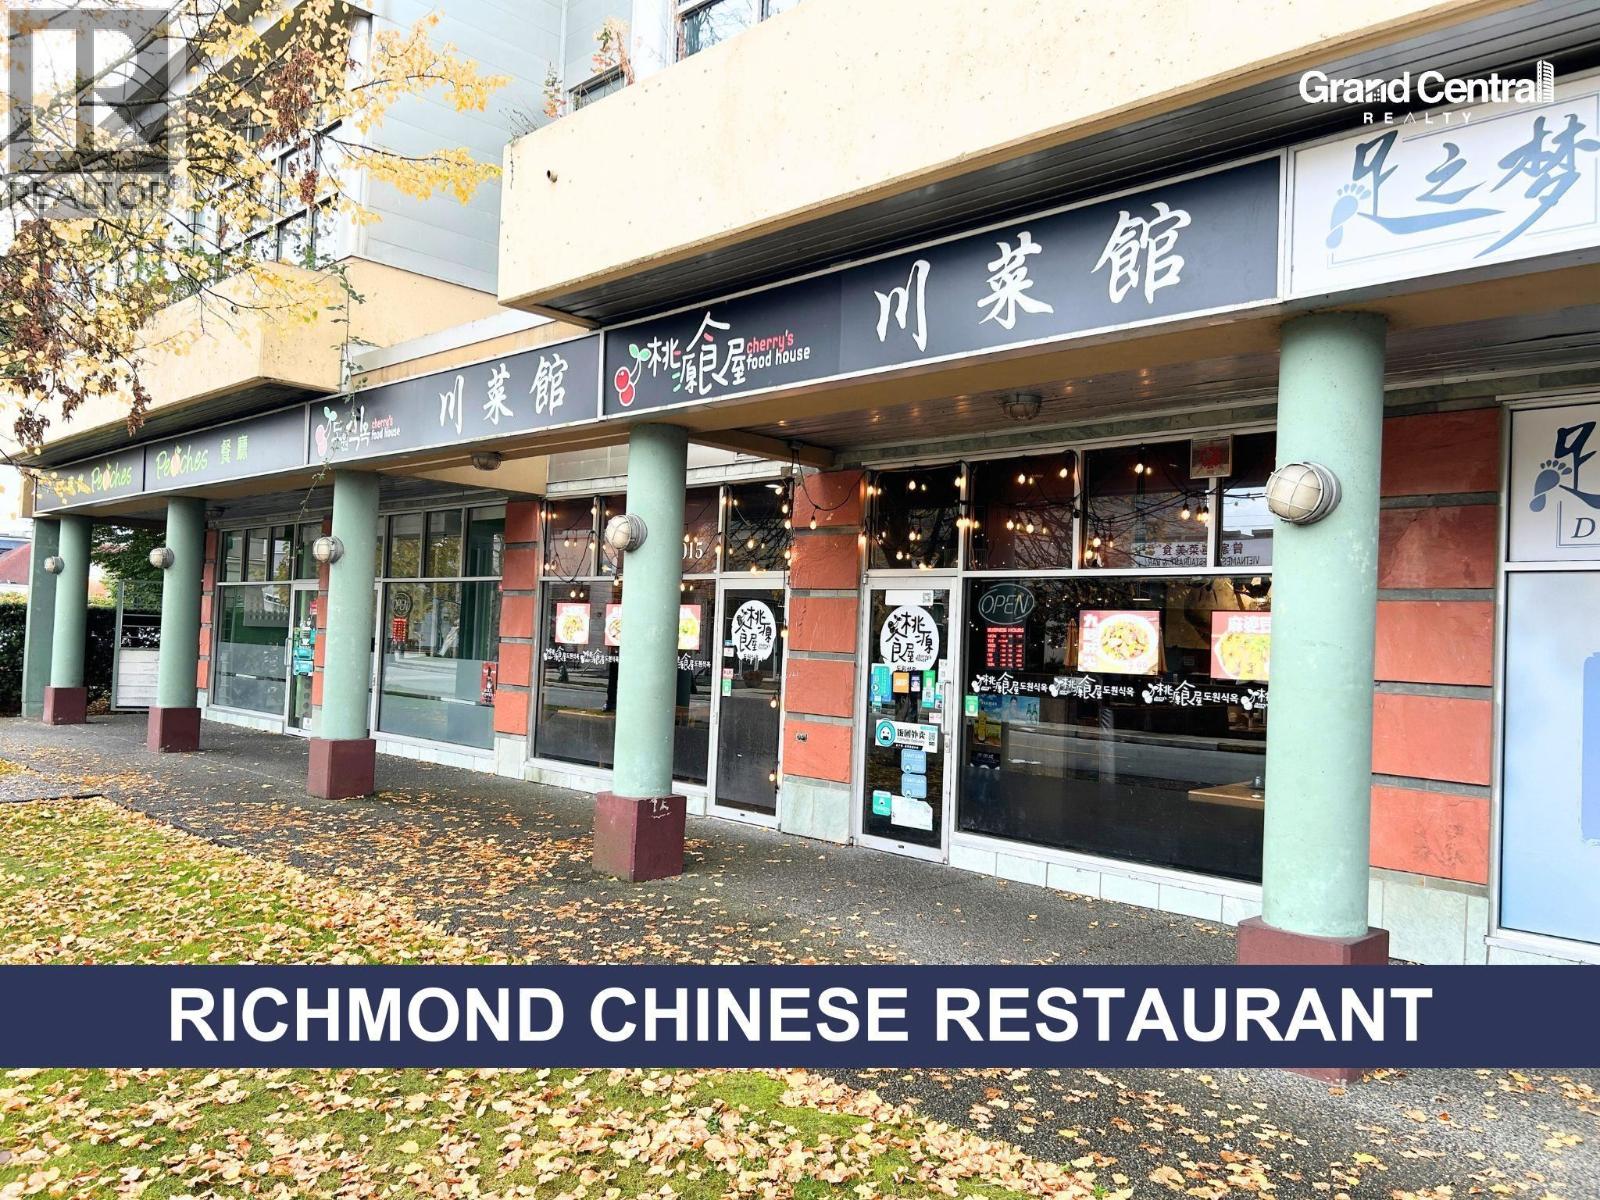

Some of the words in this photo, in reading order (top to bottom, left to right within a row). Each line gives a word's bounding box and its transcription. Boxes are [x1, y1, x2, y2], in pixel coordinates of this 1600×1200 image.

[874, 201, 1192, 353] 川菜館
[746, 329, 794, 354] cherry's
[746, 350, 772, 371] food
[775, 345, 811, 365] house
[438, 353, 569, 436] 川菜館
[371, 427, 386, 441] food
[385, 425, 401, 439] house
[154, 445, 209, 481] Peaches
[981, 594, 1031, 616] OPEN
